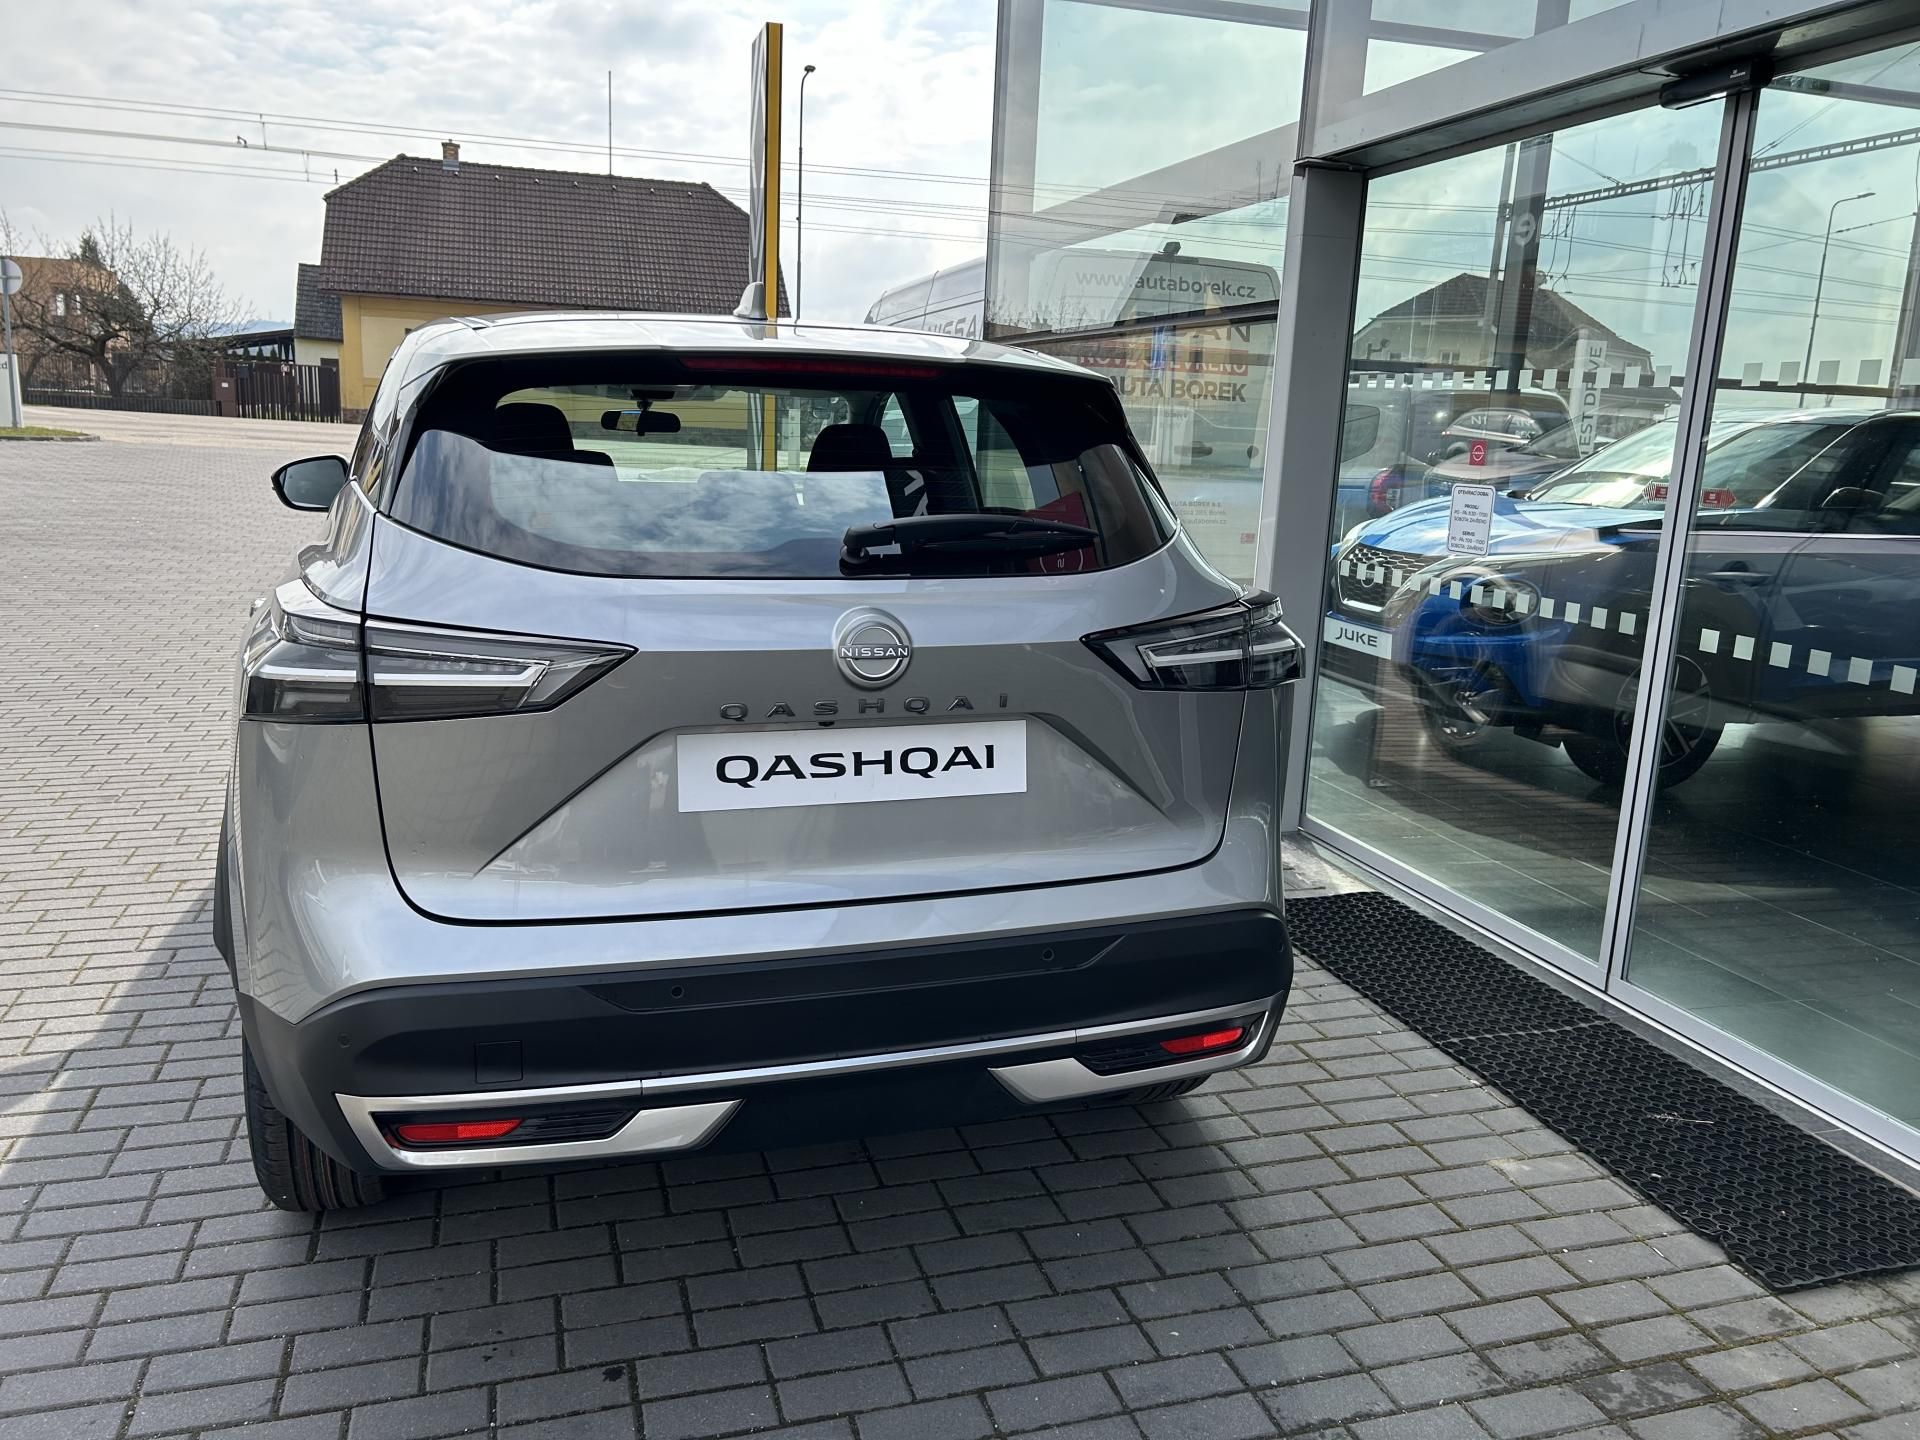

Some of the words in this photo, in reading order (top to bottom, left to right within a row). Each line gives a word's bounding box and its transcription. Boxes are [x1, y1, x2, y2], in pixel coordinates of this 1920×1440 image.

[1075, 271, 1257, 299] www.autaborek.cz
[1171, 381, 1248, 402] BOREK
[1335, 626, 1379, 648] JUKE
[841, 645, 909, 658] NISSAN
[719, 693, 1009, 722] QASHQAI
[715, 743, 996, 789] QASHQAI
